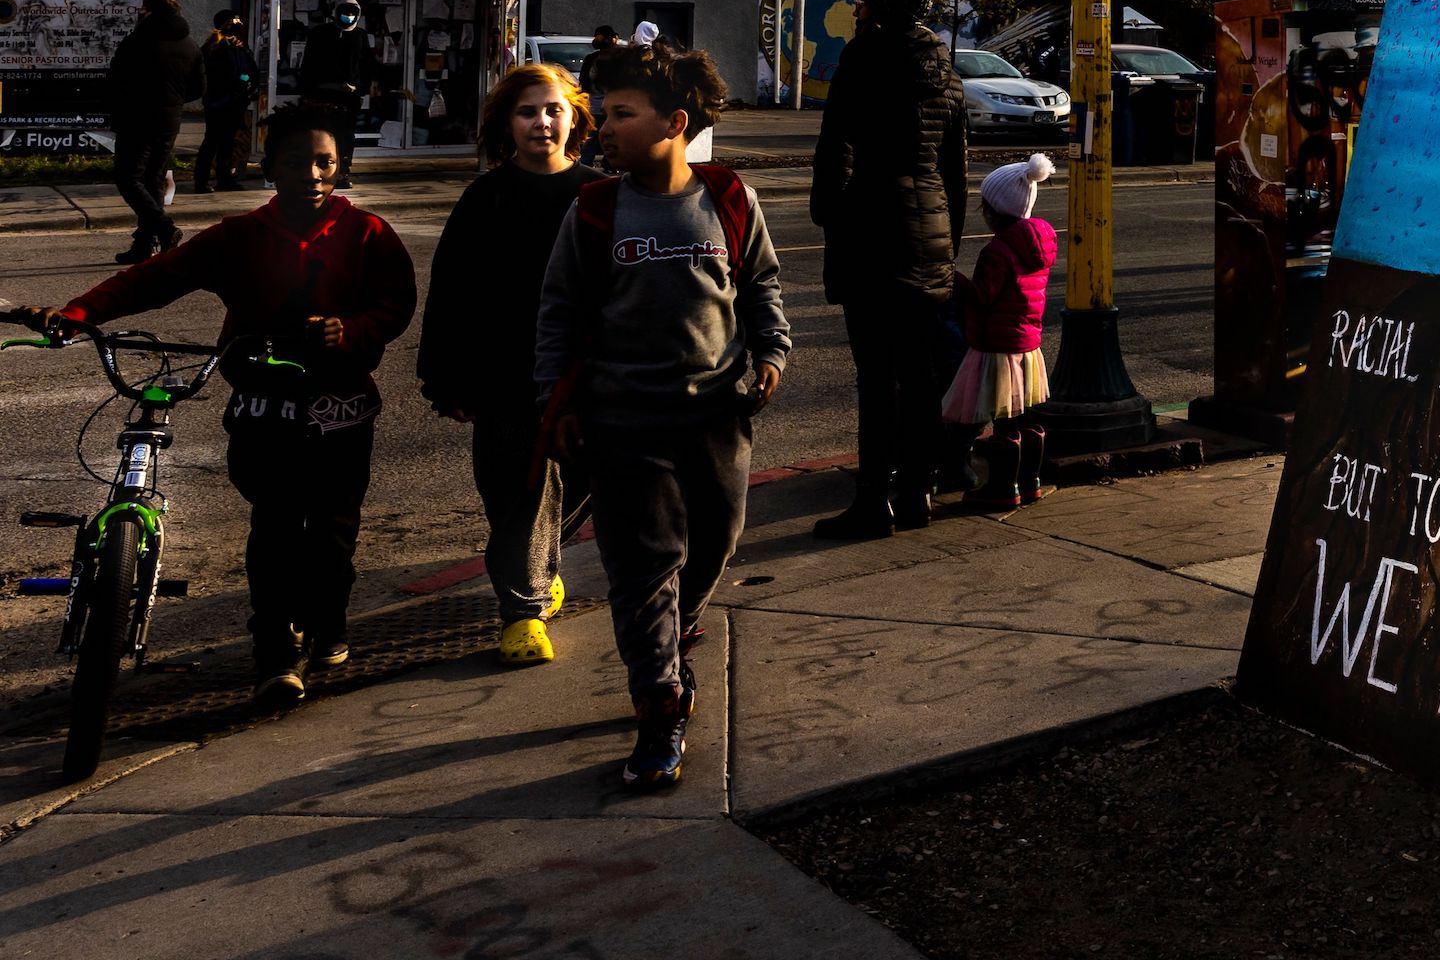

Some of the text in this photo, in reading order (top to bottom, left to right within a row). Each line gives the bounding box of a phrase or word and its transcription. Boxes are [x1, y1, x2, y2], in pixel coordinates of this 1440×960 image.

[22, 6, 67, 16] Worldwide
[69, 6, 109, 16] Outreach
[111, 6, 123, 15] for
[1, 56, 33, 65] SENIOR
[35, 56, 70, 65] PASTOR
[72, 56, 104, 65] CURTIS
[26, 133, 73, 151] Floyd
[612, 236, 729, 269] Champion
[1328, 310, 1419, 384] RACIAL
[1323, 452, 1386, 522] BUT
[1309, 538, 1419, 694] WE
